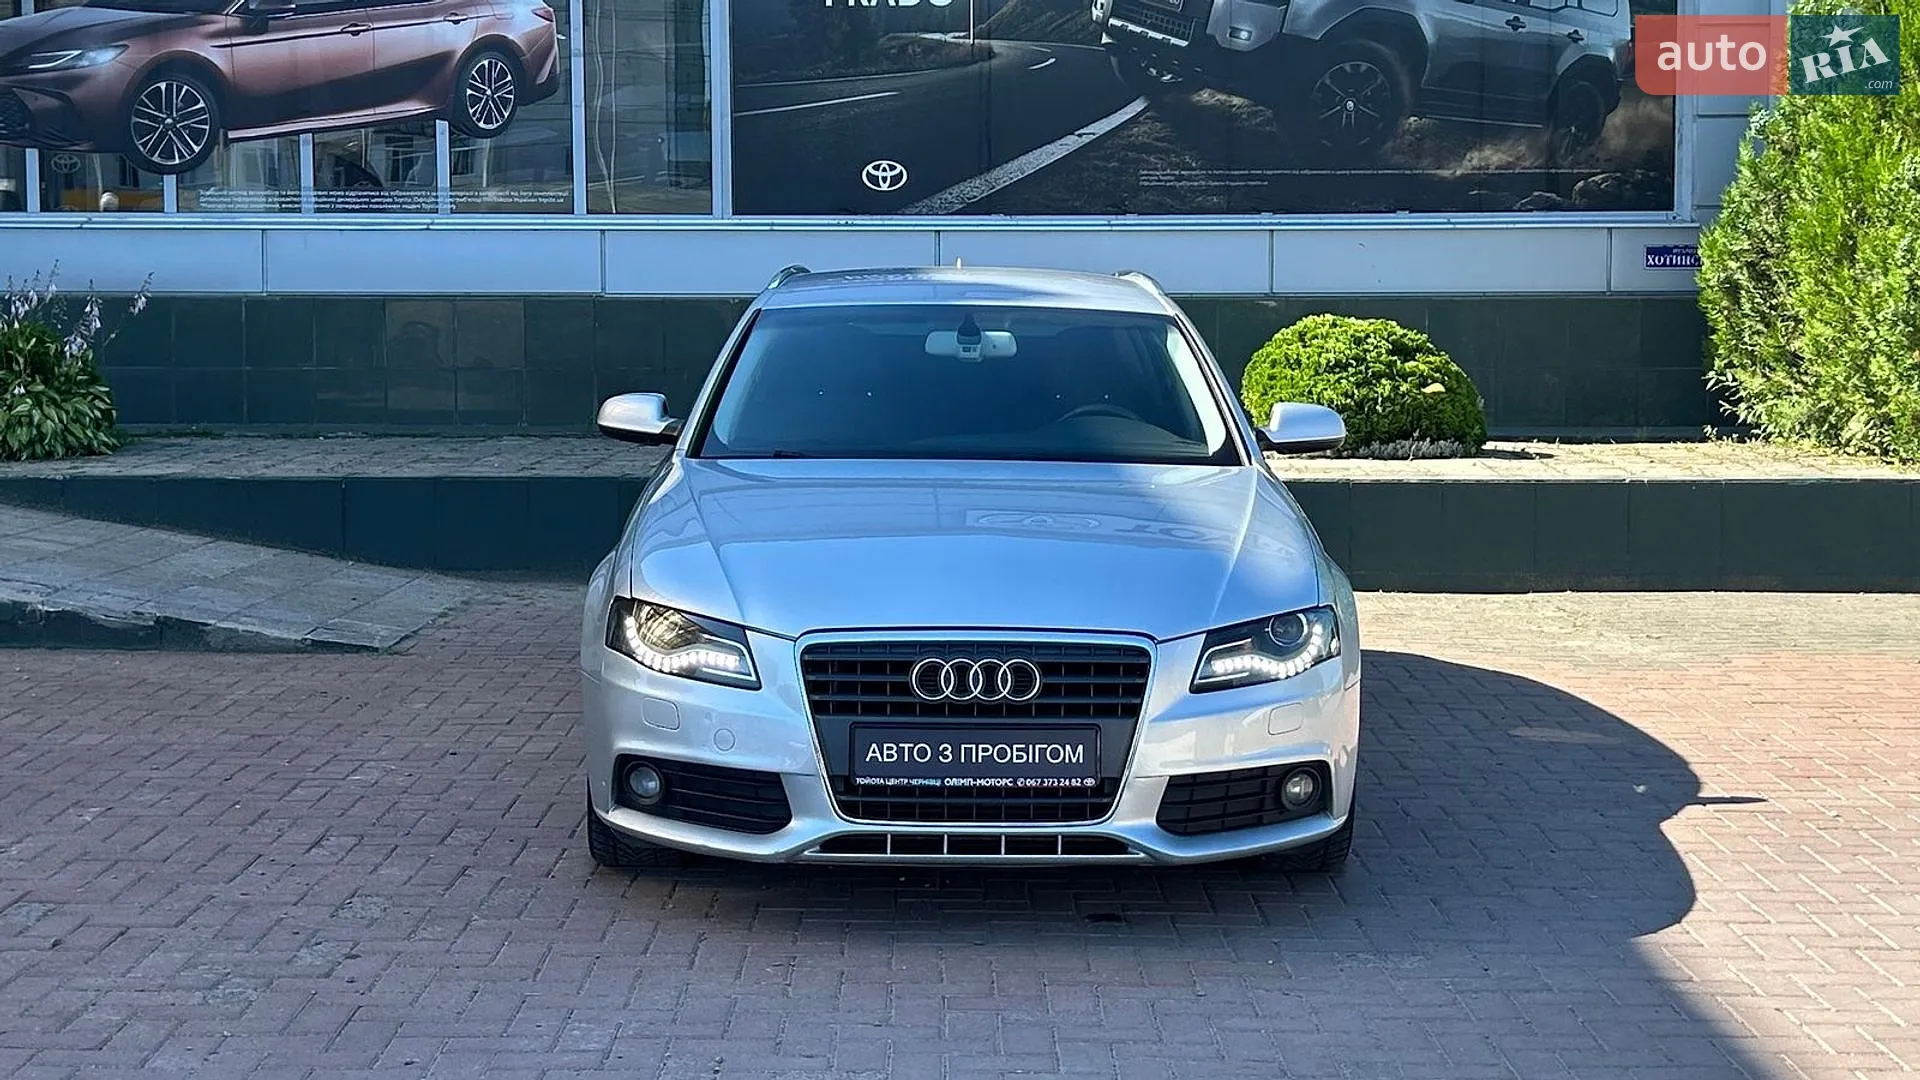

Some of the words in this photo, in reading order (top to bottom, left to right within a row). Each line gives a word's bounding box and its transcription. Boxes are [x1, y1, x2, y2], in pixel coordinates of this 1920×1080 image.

[1647, 254, 1699, 266] ХОТИНС
[865, 743, 932, 762] АВТО
[960, 744, 1084, 763] ПРОБІГОМ
[856, 777, 884, 785] ТОЙОТА
[886, 778, 908, 786] ЦЕНТР
[944, 777, 1013, 787] ОЛІМП-МОТОРС
[1026, 778, 1041, 787] 067
[1043, 778, 1058, 787] 373
[1060, 778, 1070, 787] 24
